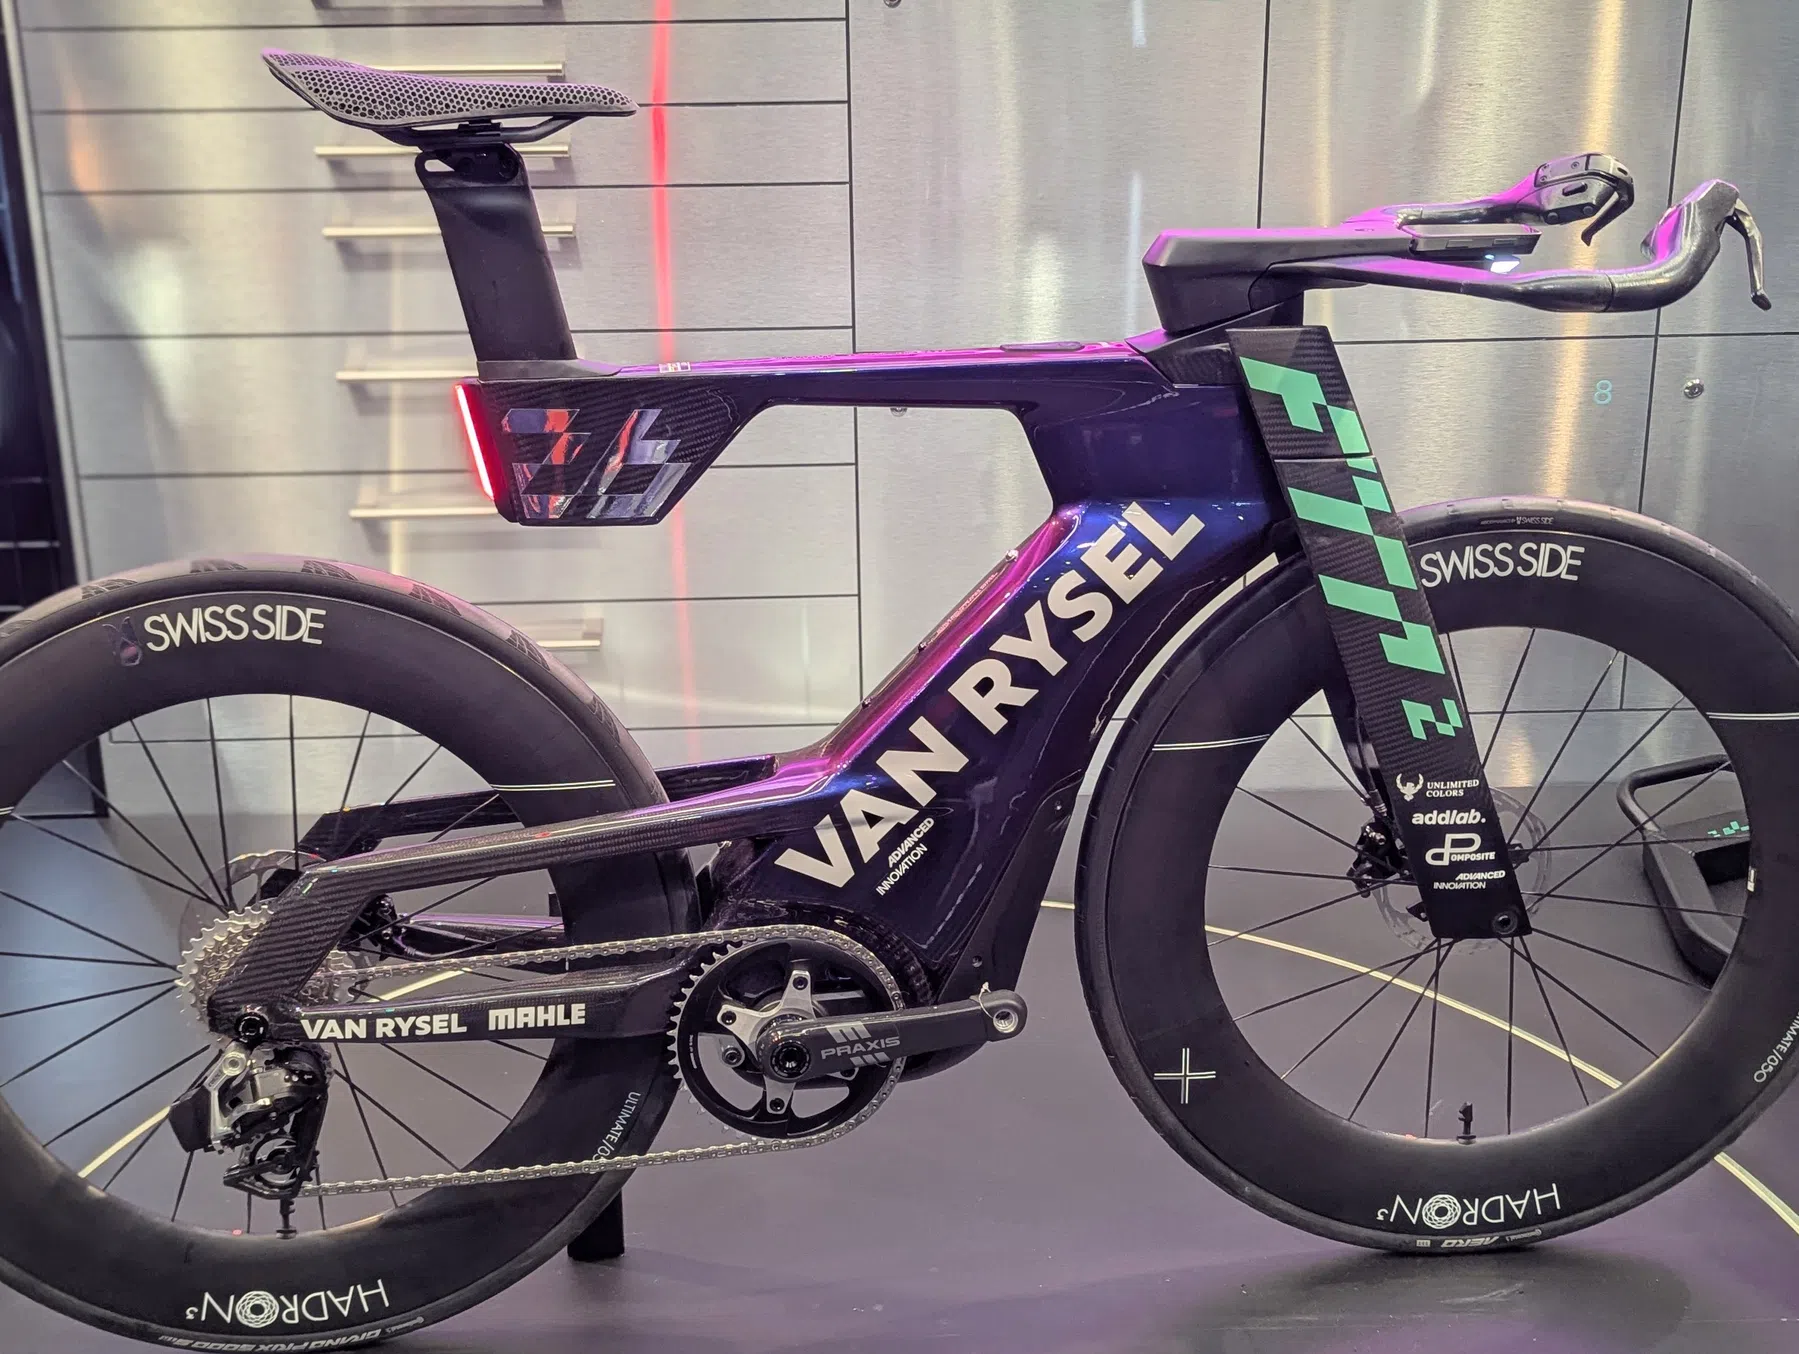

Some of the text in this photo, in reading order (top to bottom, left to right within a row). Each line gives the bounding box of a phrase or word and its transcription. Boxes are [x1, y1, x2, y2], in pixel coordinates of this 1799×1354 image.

[1594, 380, 1612, 404] 8
[1420, 542, 1585, 588] SWISS SIDE
[144, 604, 327, 652] SWISS SIDE
[774, 501, 1206, 888] VAN RYSEL
[1426, 789, 1465, 798] COLORS
[1427, 779, 1480, 790] UNLIMITED
[1411, 808, 1487, 825] addlab.
[888, 817, 935, 869] ADVANCED
[875, 842, 928, 896] INNOVATION
[1455, 869, 1506, 881] ADVANCED
[1433, 881, 1487, 890] INNOVATION
[300, 1003, 586, 1040] VAN RYSEL MAHLE
[820, 1036, 900, 1060] PRAXIS
[1441, 1235, 1500, 1248] AERO
[256, 1341, 309, 1353] PRIX
[309, 1329, 382, 1350] GRAND
